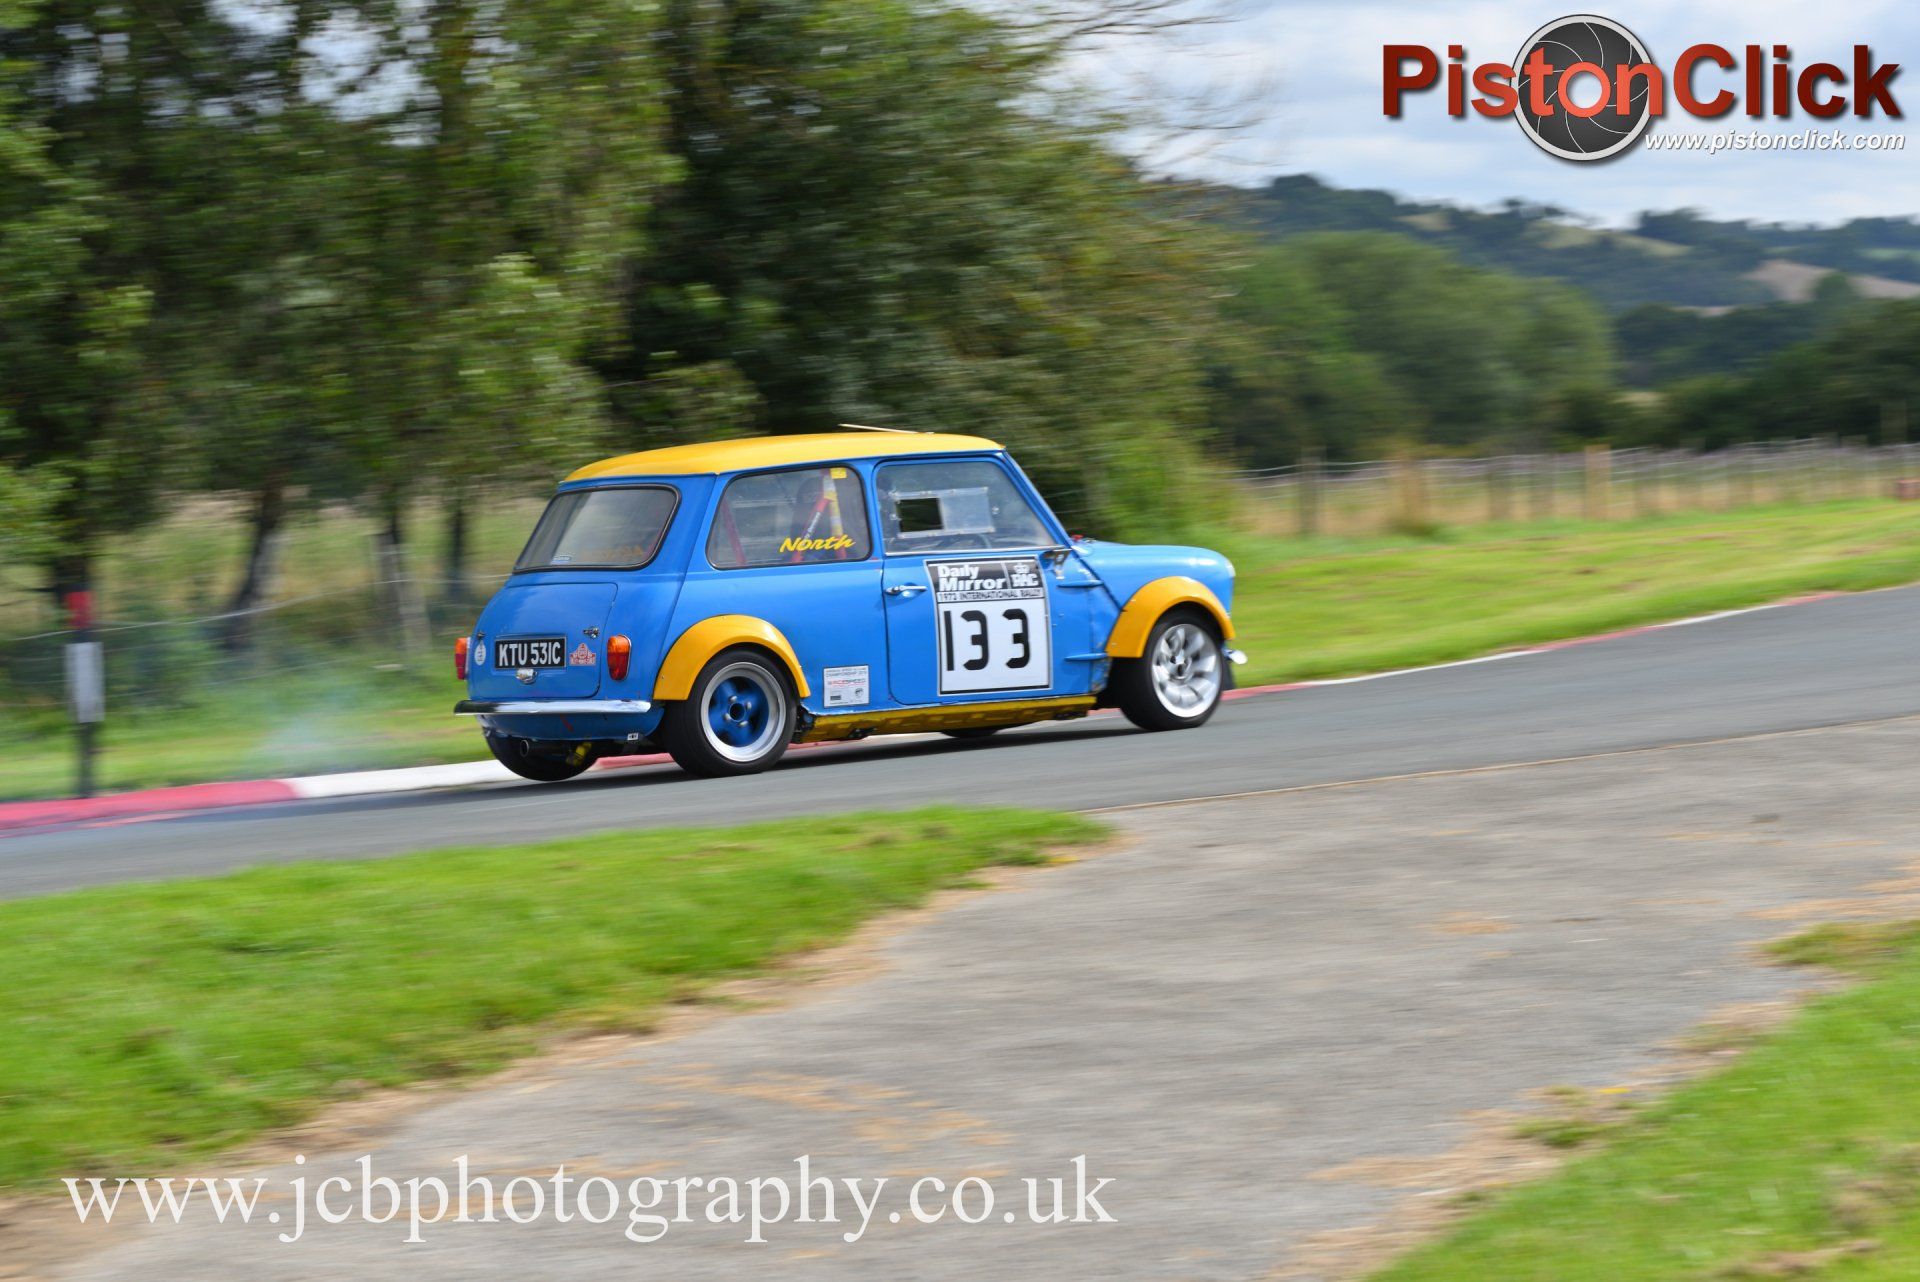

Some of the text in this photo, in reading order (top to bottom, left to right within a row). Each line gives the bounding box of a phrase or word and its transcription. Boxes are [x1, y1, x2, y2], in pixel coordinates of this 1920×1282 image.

[780, 534, 856, 552] North
[937, 564, 979, 579] Daily
[938, 577, 1006, 592] Mirror
[1011, 573, 1039, 588] RAC
[960, 588, 1018, 600] INTERNATIONAL
[943, 608, 1031, 672] 133
[499, 643, 528, 666] KTU
[530, 642, 561, 665] 531C
